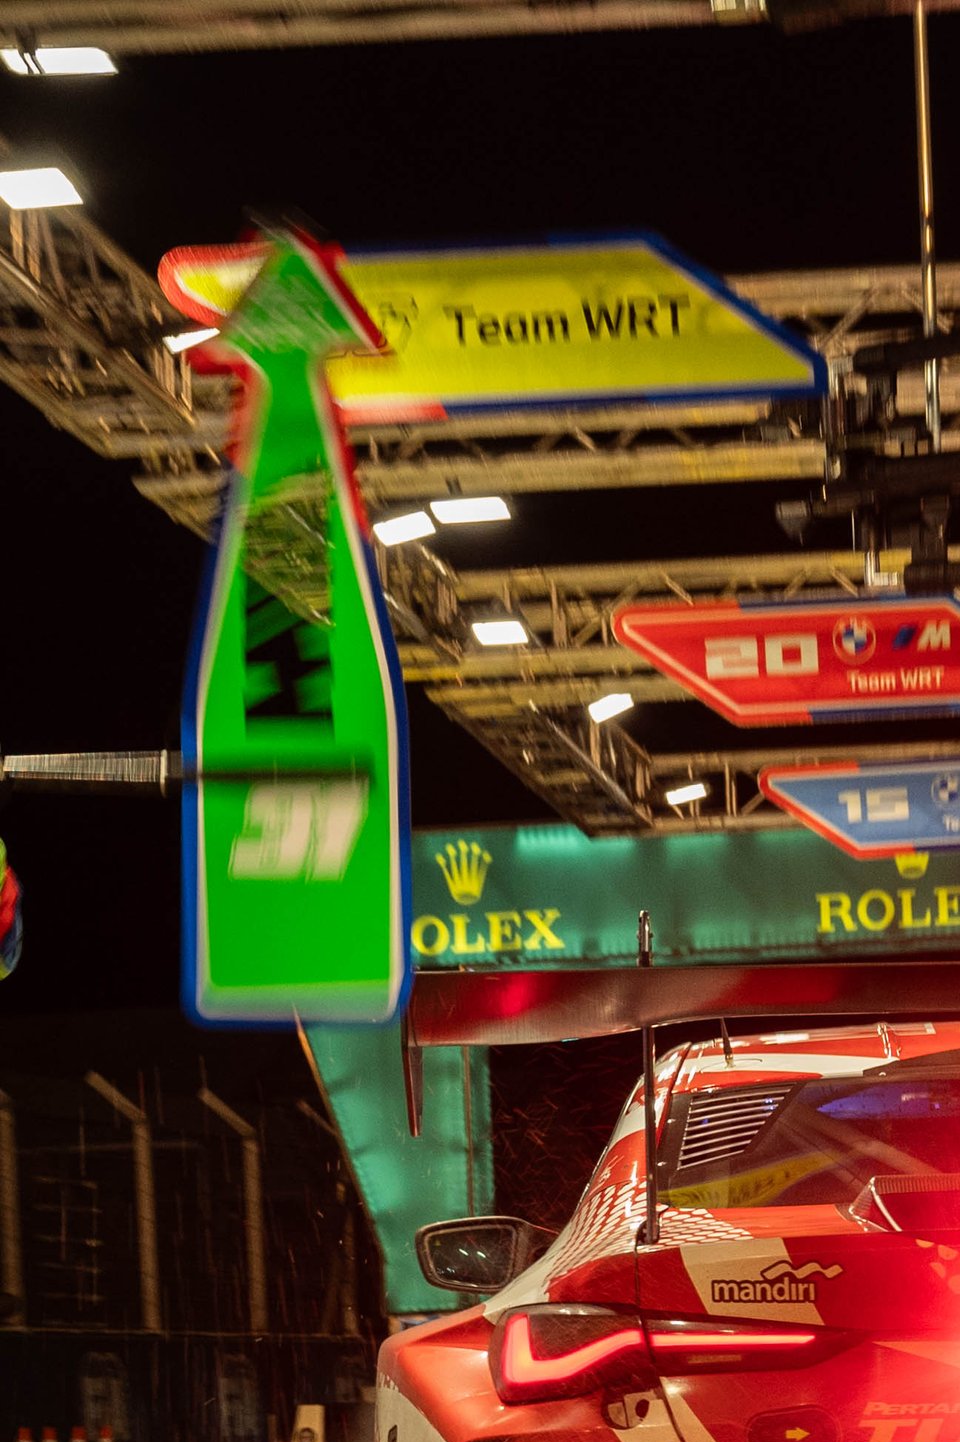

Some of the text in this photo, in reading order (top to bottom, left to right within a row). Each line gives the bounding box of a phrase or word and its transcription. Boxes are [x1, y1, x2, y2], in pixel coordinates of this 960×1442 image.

[443, 293, 691, 346] Team WRT
[705, 634, 819, 679] 20
[847, 665, 944, 693] Team WRT
[838, 786, 909, 823] 15
[410, 908, 565, 956] OLEX
[713, 1276, 816, 1302] mandiri
